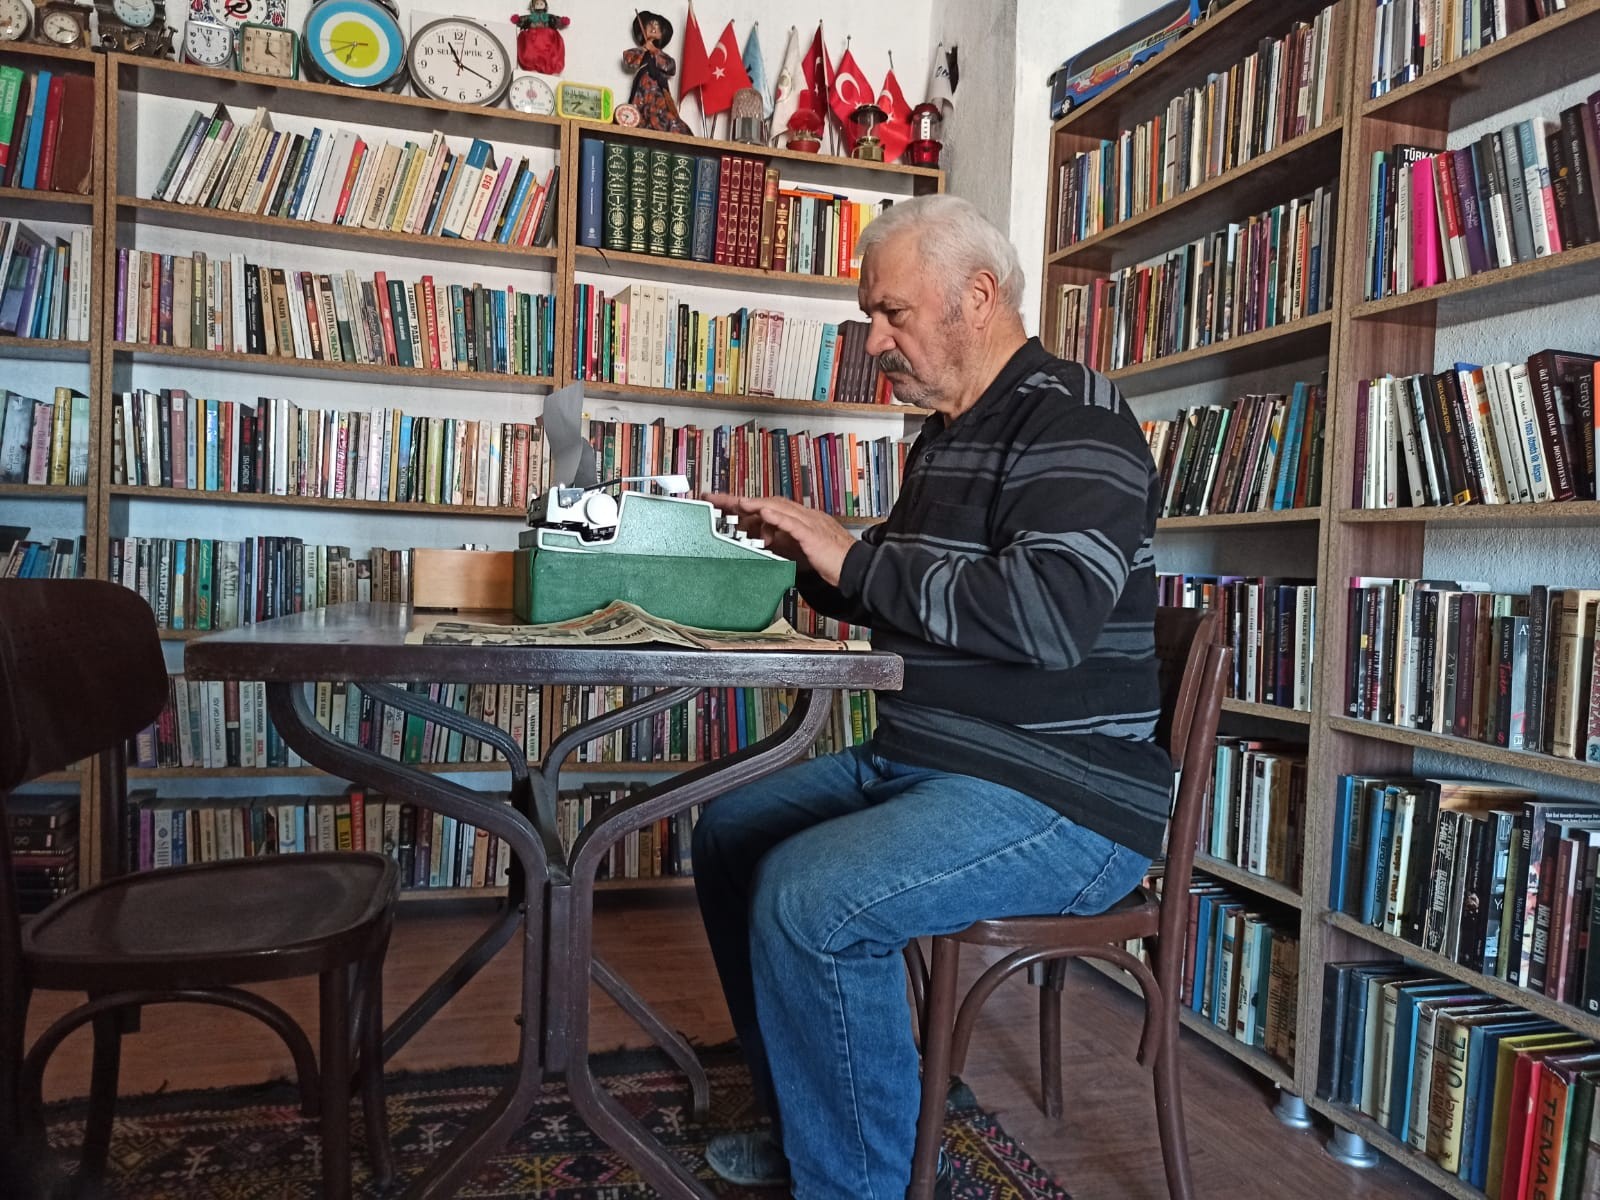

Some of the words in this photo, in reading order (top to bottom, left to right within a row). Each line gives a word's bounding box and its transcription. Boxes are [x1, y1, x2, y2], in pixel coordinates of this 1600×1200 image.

[438, 35, 444, 44] 11
[454, 32, 463, 40] 12
[424, 47, 434, 56] 10
[486, 51, 493, 60] 2
[421, 60, 427, 68] 9
[428, 75, 434, 84] 8
[442, 87, 448, 95] 7
[459, 91, 465, 100] 6
[476, 89, 482, 98] 5
[410, 325, 419, 344] PARA
[1541, 384, 1553, 411] EVİNDEN
[1578, 374, 1592, 417] Feraye
[160, 563, 169, 595] AKREP
[158, 596, 169, 622] DÖLÜ
[1437, 821, 1448, 855] HAILEY
[1445, 820, 1456, 861] ARTHUR
[1514, 896, 1524, 922] Michael
[1513, 924, 1522, 941] Todd
[1446, 1037, 1466, 1088] OTEL
